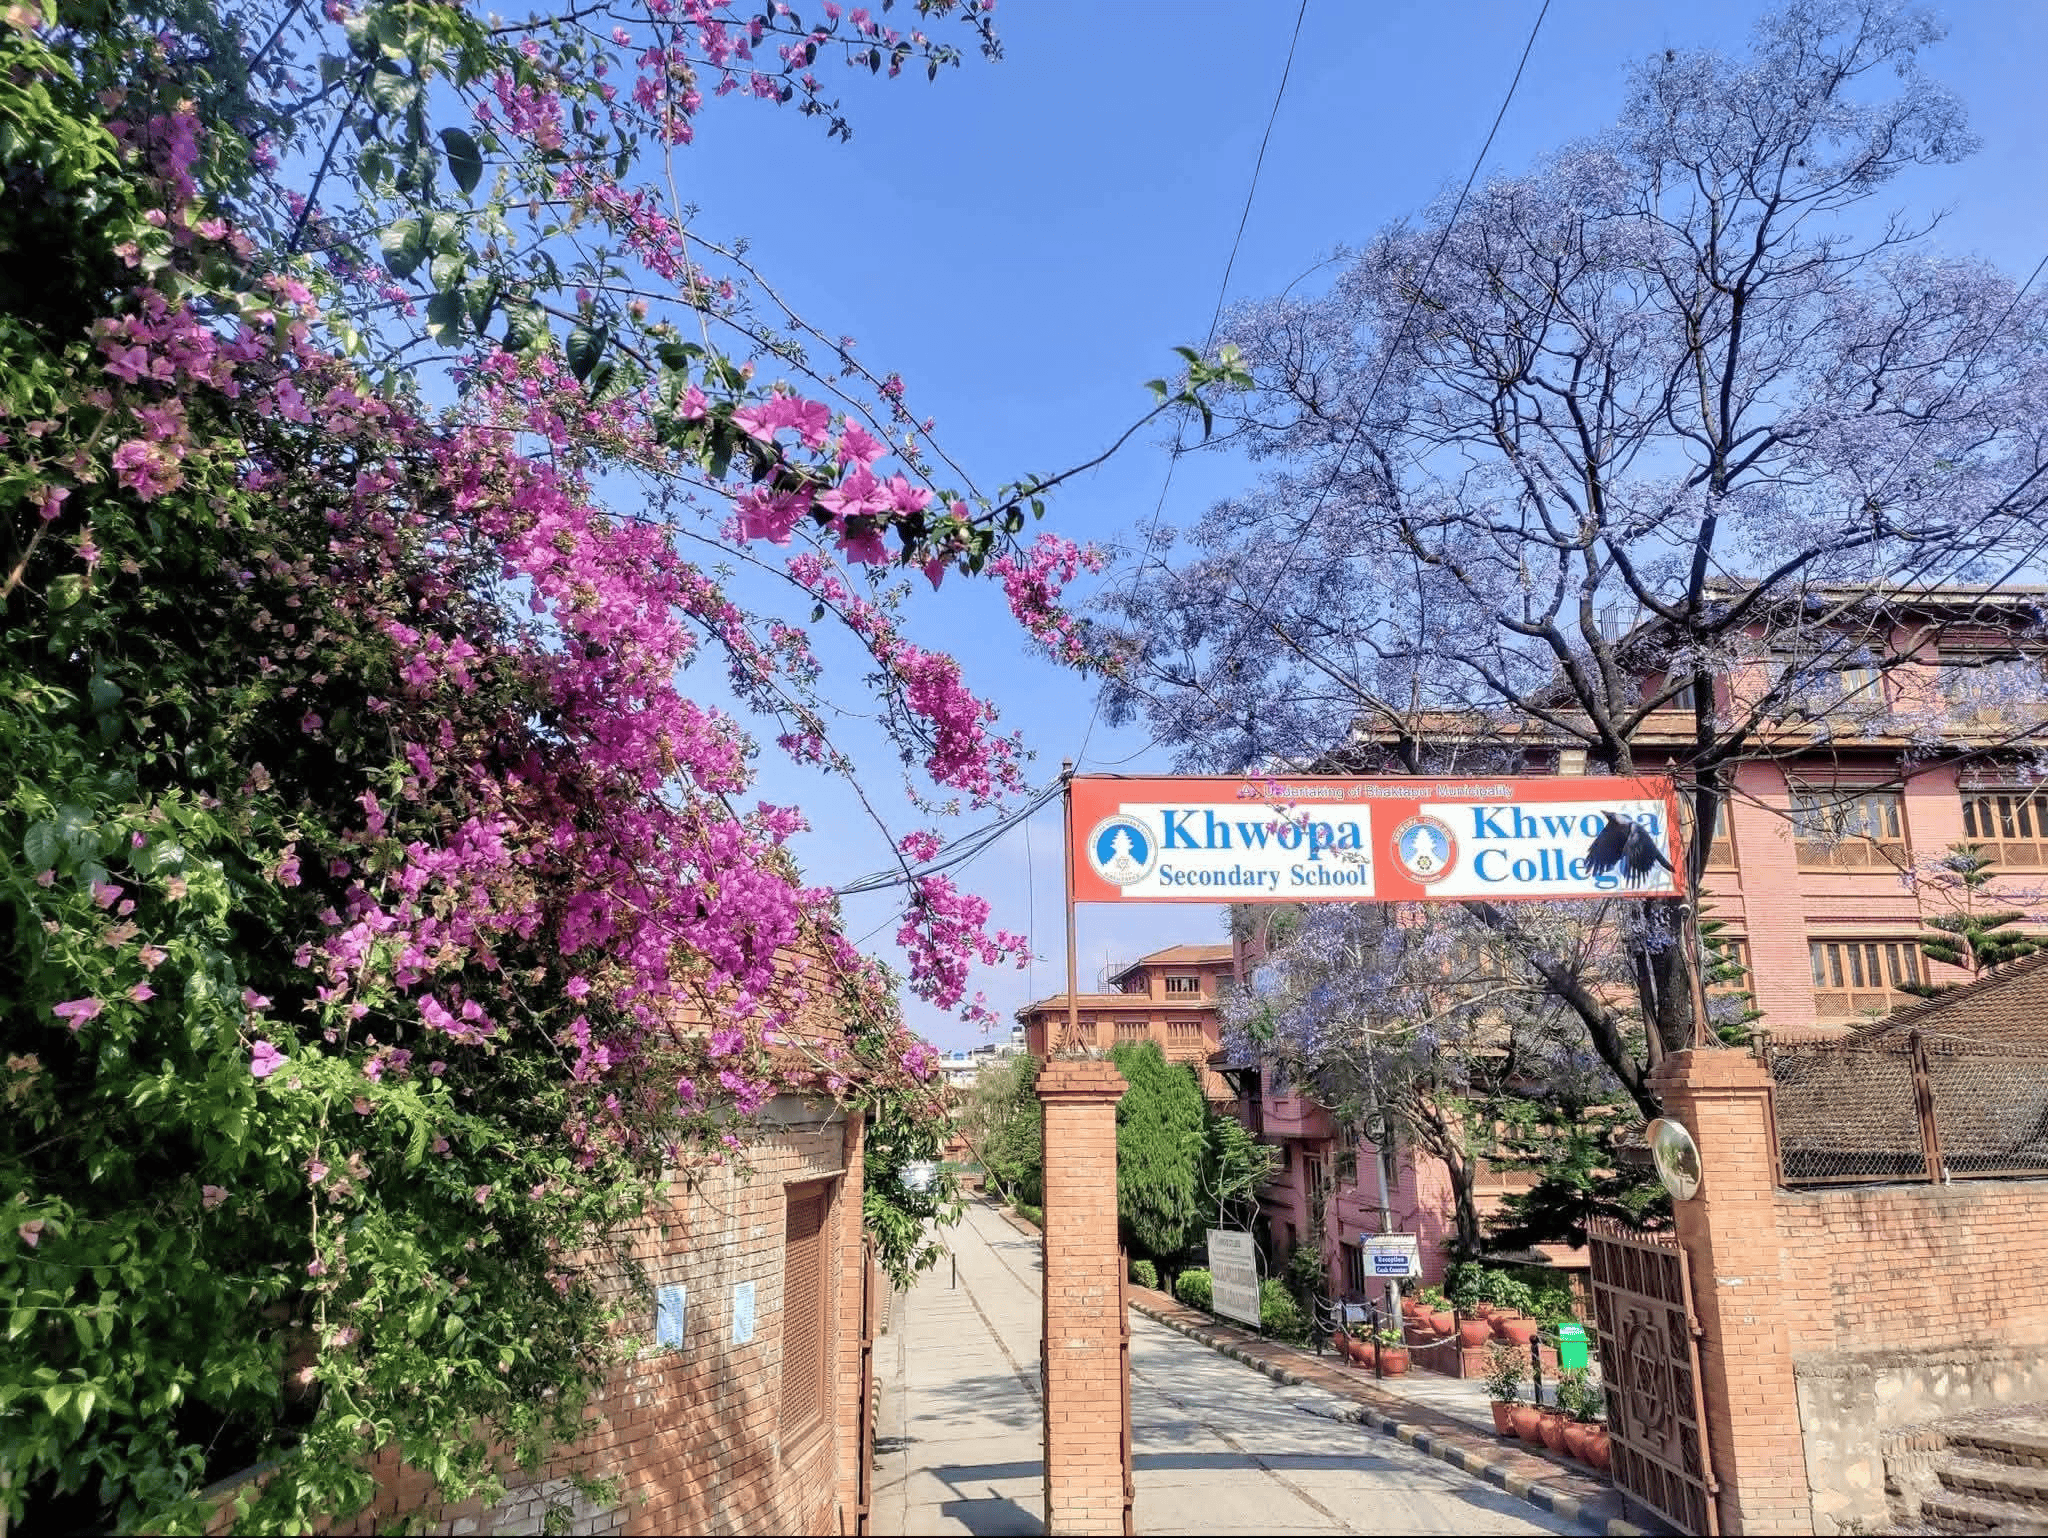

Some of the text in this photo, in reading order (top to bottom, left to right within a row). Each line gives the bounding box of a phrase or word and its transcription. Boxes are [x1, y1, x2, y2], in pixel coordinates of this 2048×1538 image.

[1348, 784, 1361, 796] of
[1365, 784, 1432, 800] Bhaktapur
[1435, 784, 1513, 800] Municipality
[1159, 808, 1364, 861] Khwopa
[1471, 806, 1662, 839] Khwoa
[1159, 863, 1281, 891] Secondary
[1290, 863, 1368, 886] School
[1473, 848, 1628, 890] Colleg
